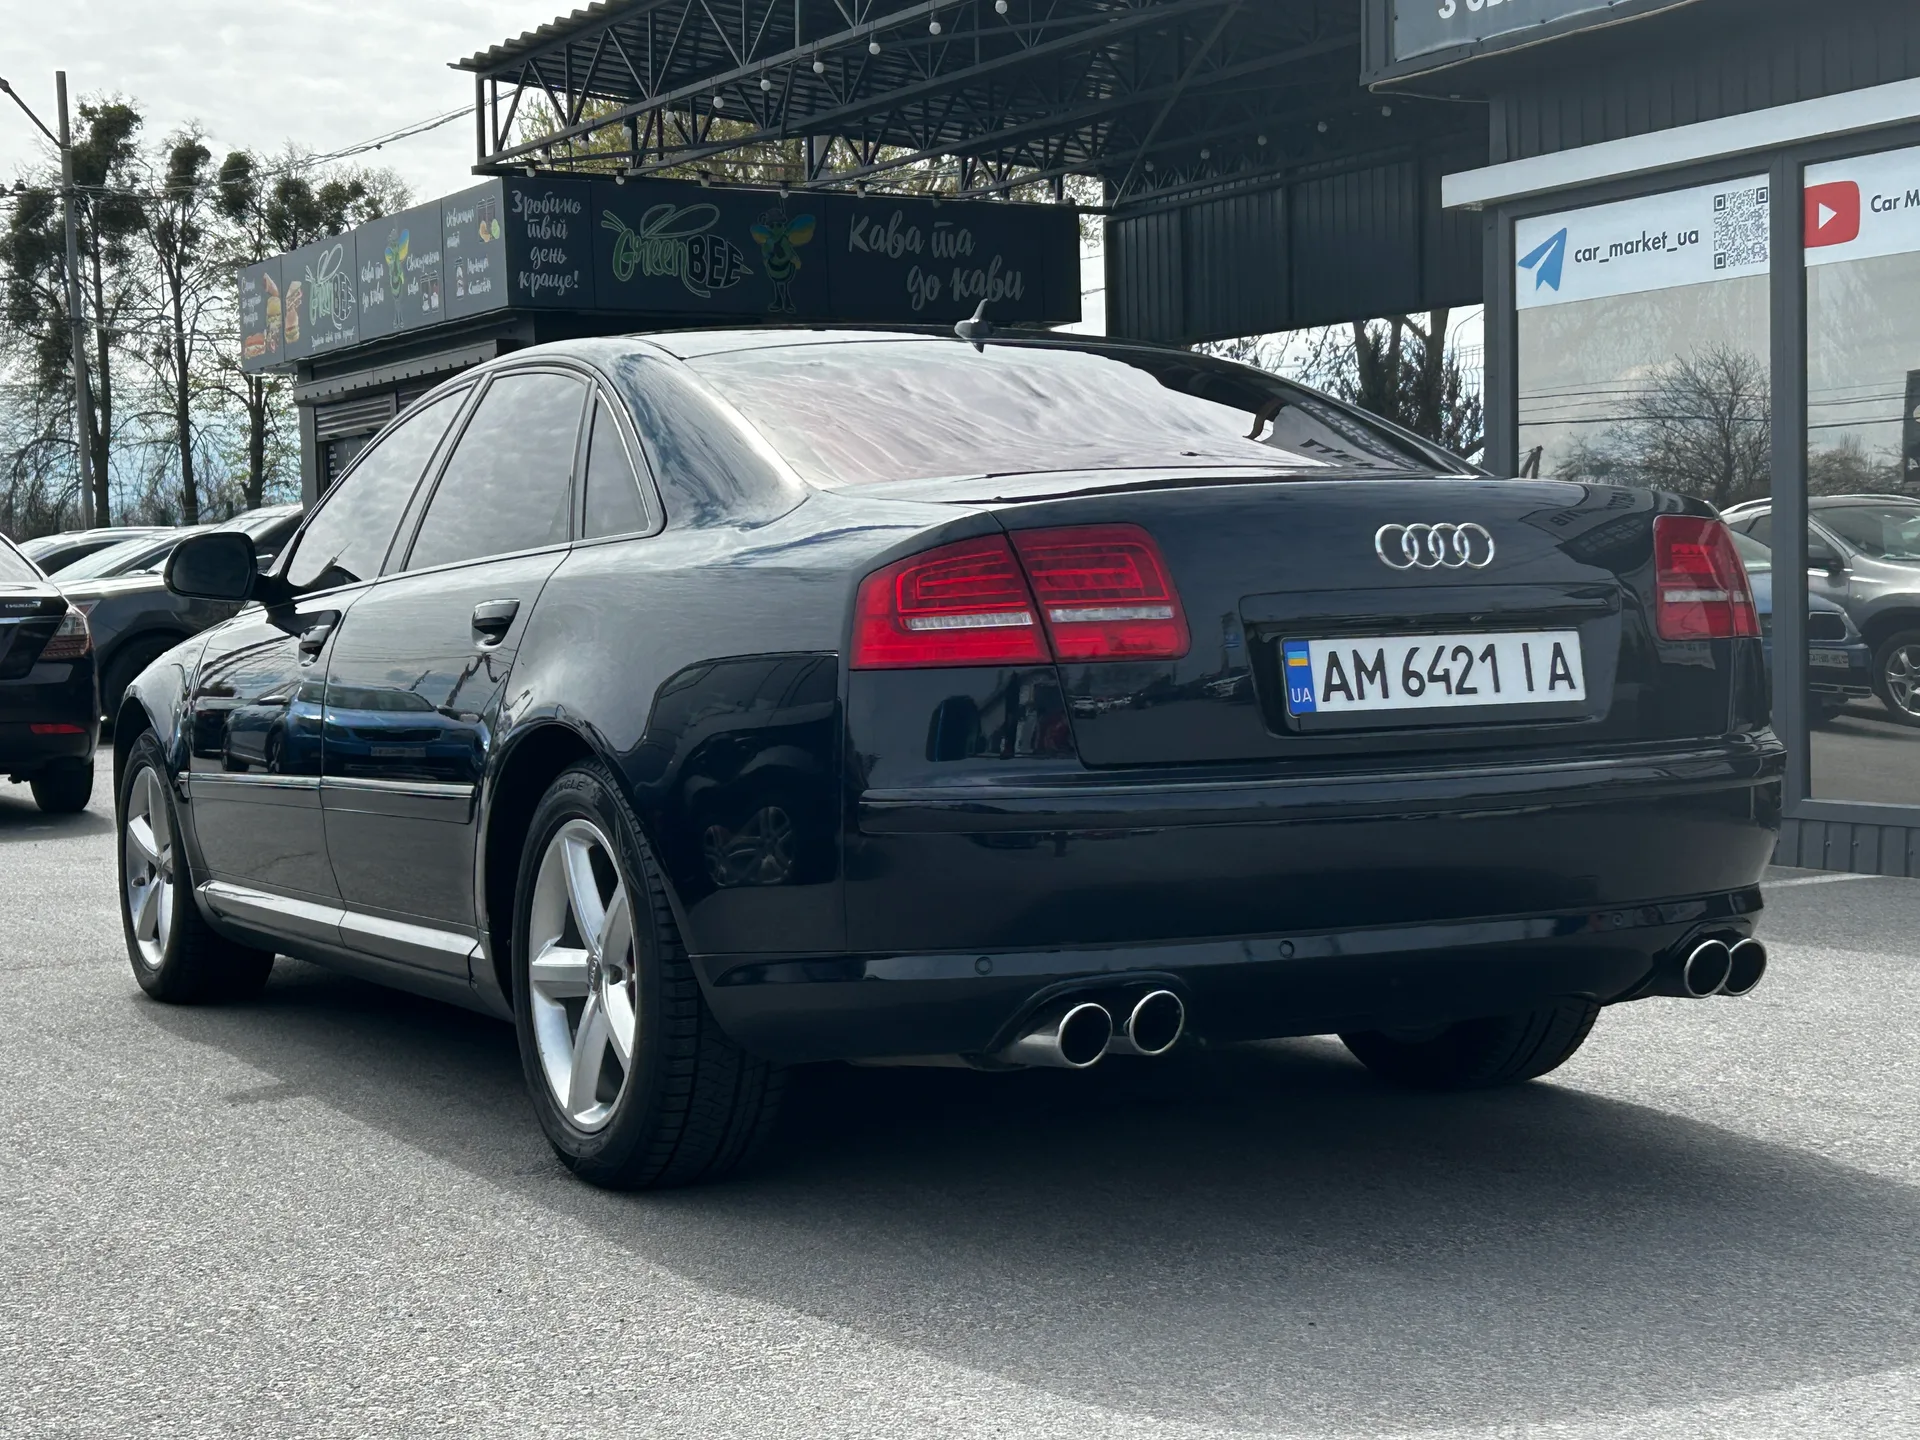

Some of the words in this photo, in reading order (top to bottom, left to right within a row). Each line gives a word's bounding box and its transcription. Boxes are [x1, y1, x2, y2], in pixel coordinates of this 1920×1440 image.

[511, 190, 582, 221] Зробимо
[1871, 195, 1901, 213] Car
[527, 218, 568, 240] твій
[849, 210, 926, 259] Кава
[931, 221, 976, 259] та
[530, 246, 568, 269] день
[1574, 229, 1699, 264] car_market_ua
[517, 270, 579, 298] краще!
[906, 265, 942, 311] до
[950, 254, 1025, 302] кави
[1322, 648, 1389, 702] AM
[1401, 643, 1501, 698] 6421
[1522, 642, 1576, 692] IA
[1292, 687, 1313, 703] UA
